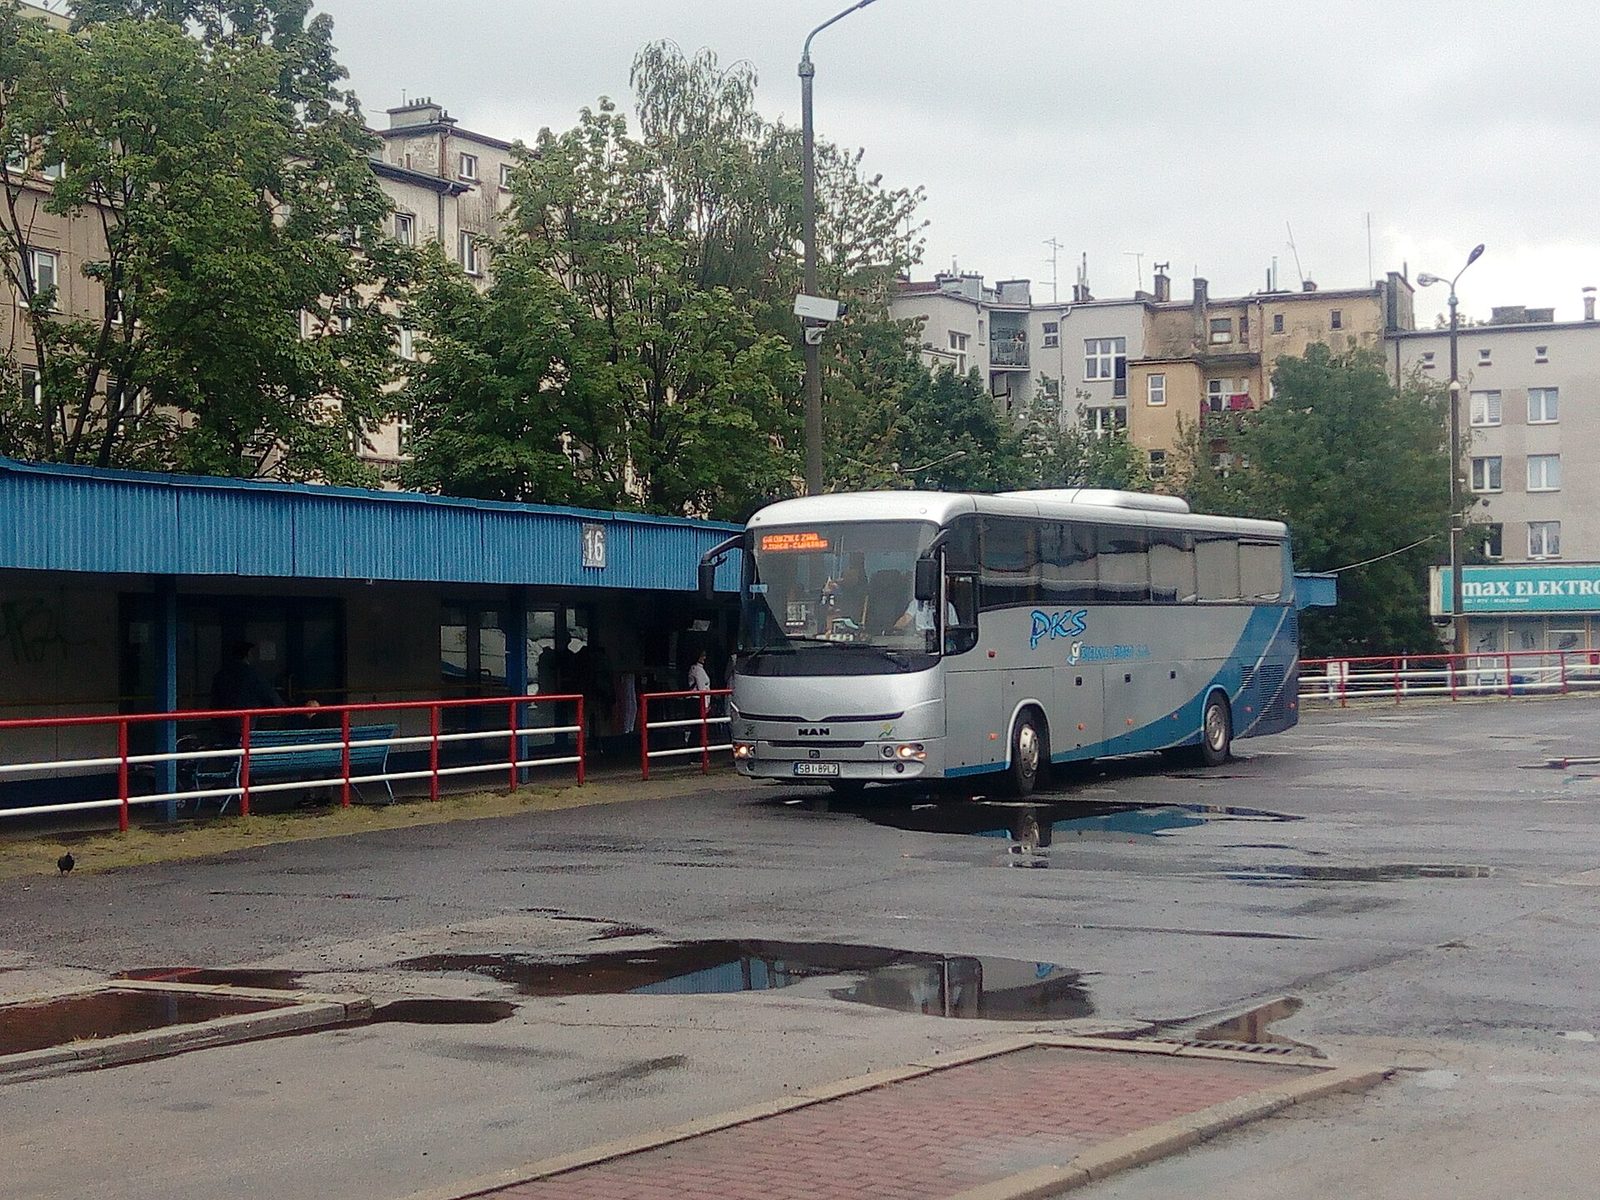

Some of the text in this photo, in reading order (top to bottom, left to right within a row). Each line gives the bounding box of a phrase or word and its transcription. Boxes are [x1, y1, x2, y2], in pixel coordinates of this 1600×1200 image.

[585, 530, 603, 561] 16
[1462, 580, 1510, 597] max
[1030, 609, 1088, 650] PKS
[798, 728, 830, 736] MAN
